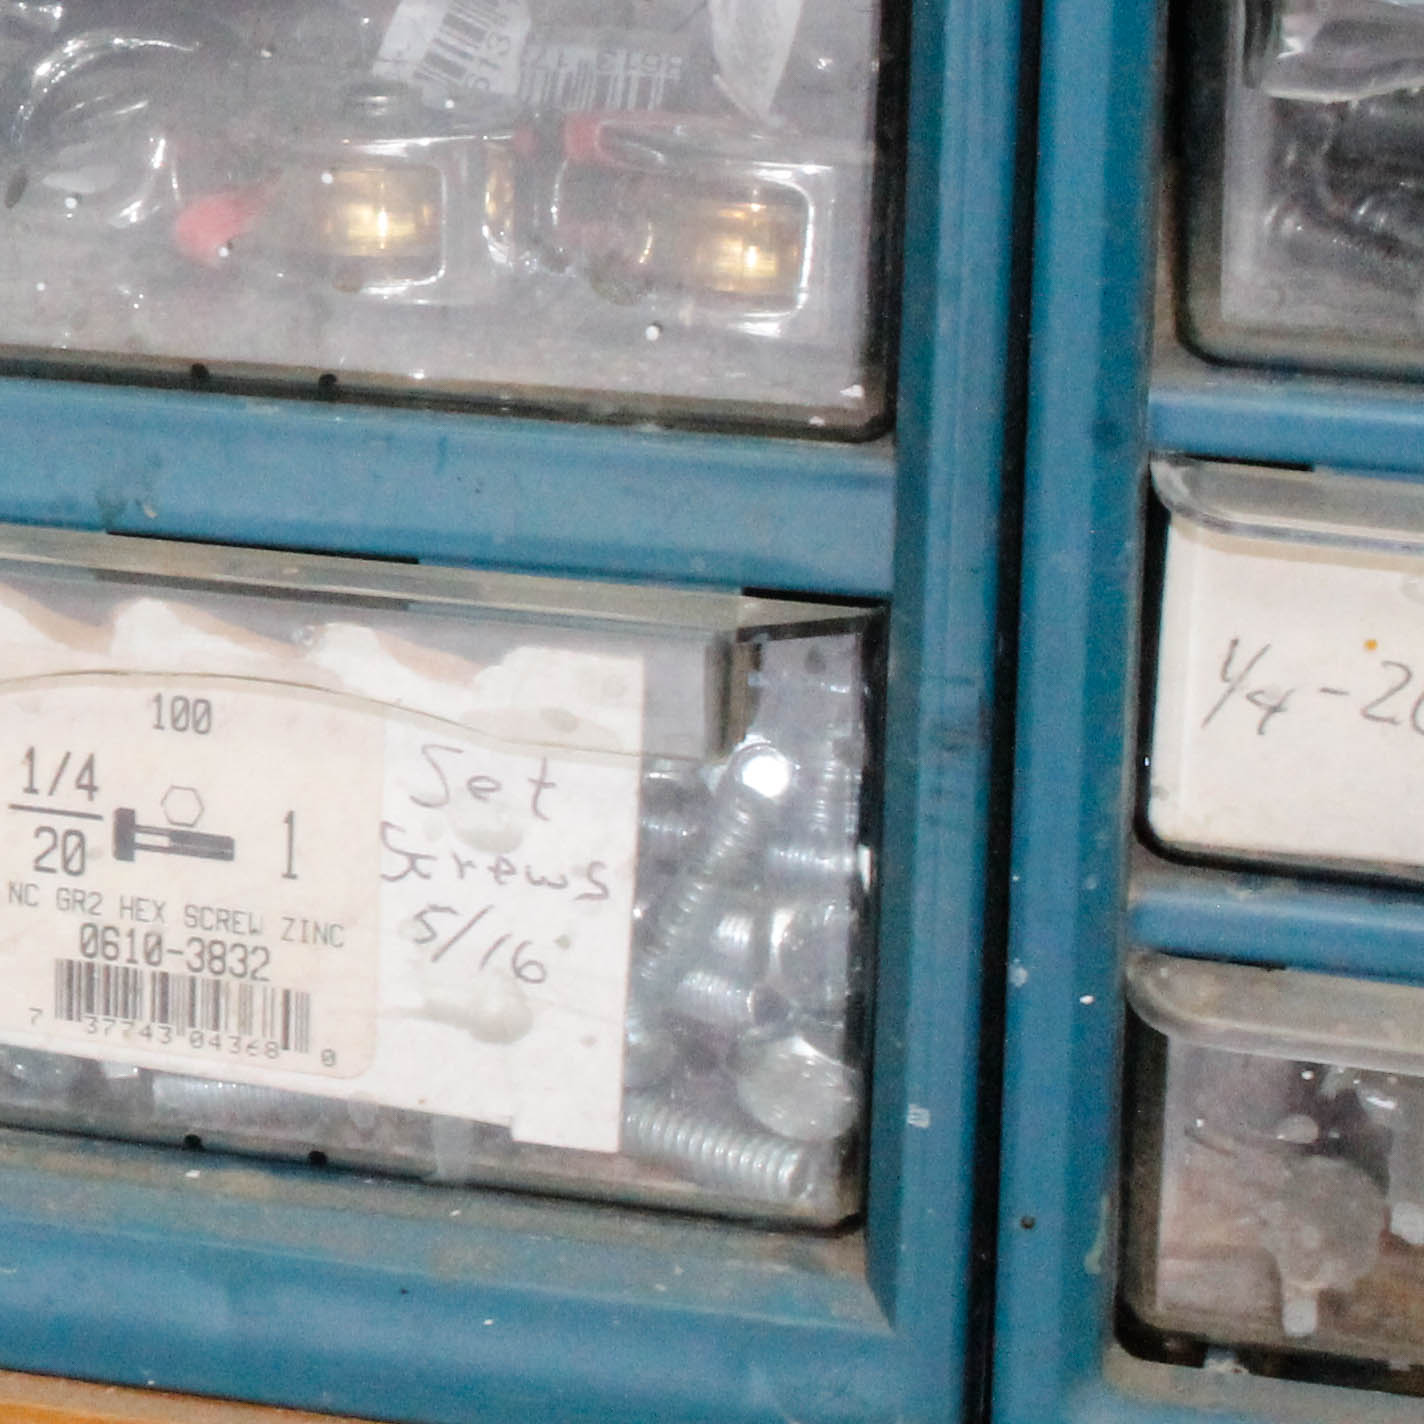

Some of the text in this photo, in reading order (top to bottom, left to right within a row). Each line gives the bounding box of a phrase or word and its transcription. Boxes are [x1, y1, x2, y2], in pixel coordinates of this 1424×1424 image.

[151, 691, 212, 736] 100
[20, 744, 101, 804] 1/4
[407, 743, 560, 822] Set
[32, 825, 87, 878] 20
[280, 808, 299, 882] 1
[380, 819, 612, 903] Screws
[8, 882, 345, 948] NC GR2 HEX SCREW ZINC
[409, 904, 550, 986] 5/16
[79, 922, 271, 982] 0610-3832
[321, 1048, 336, 1067] 0
